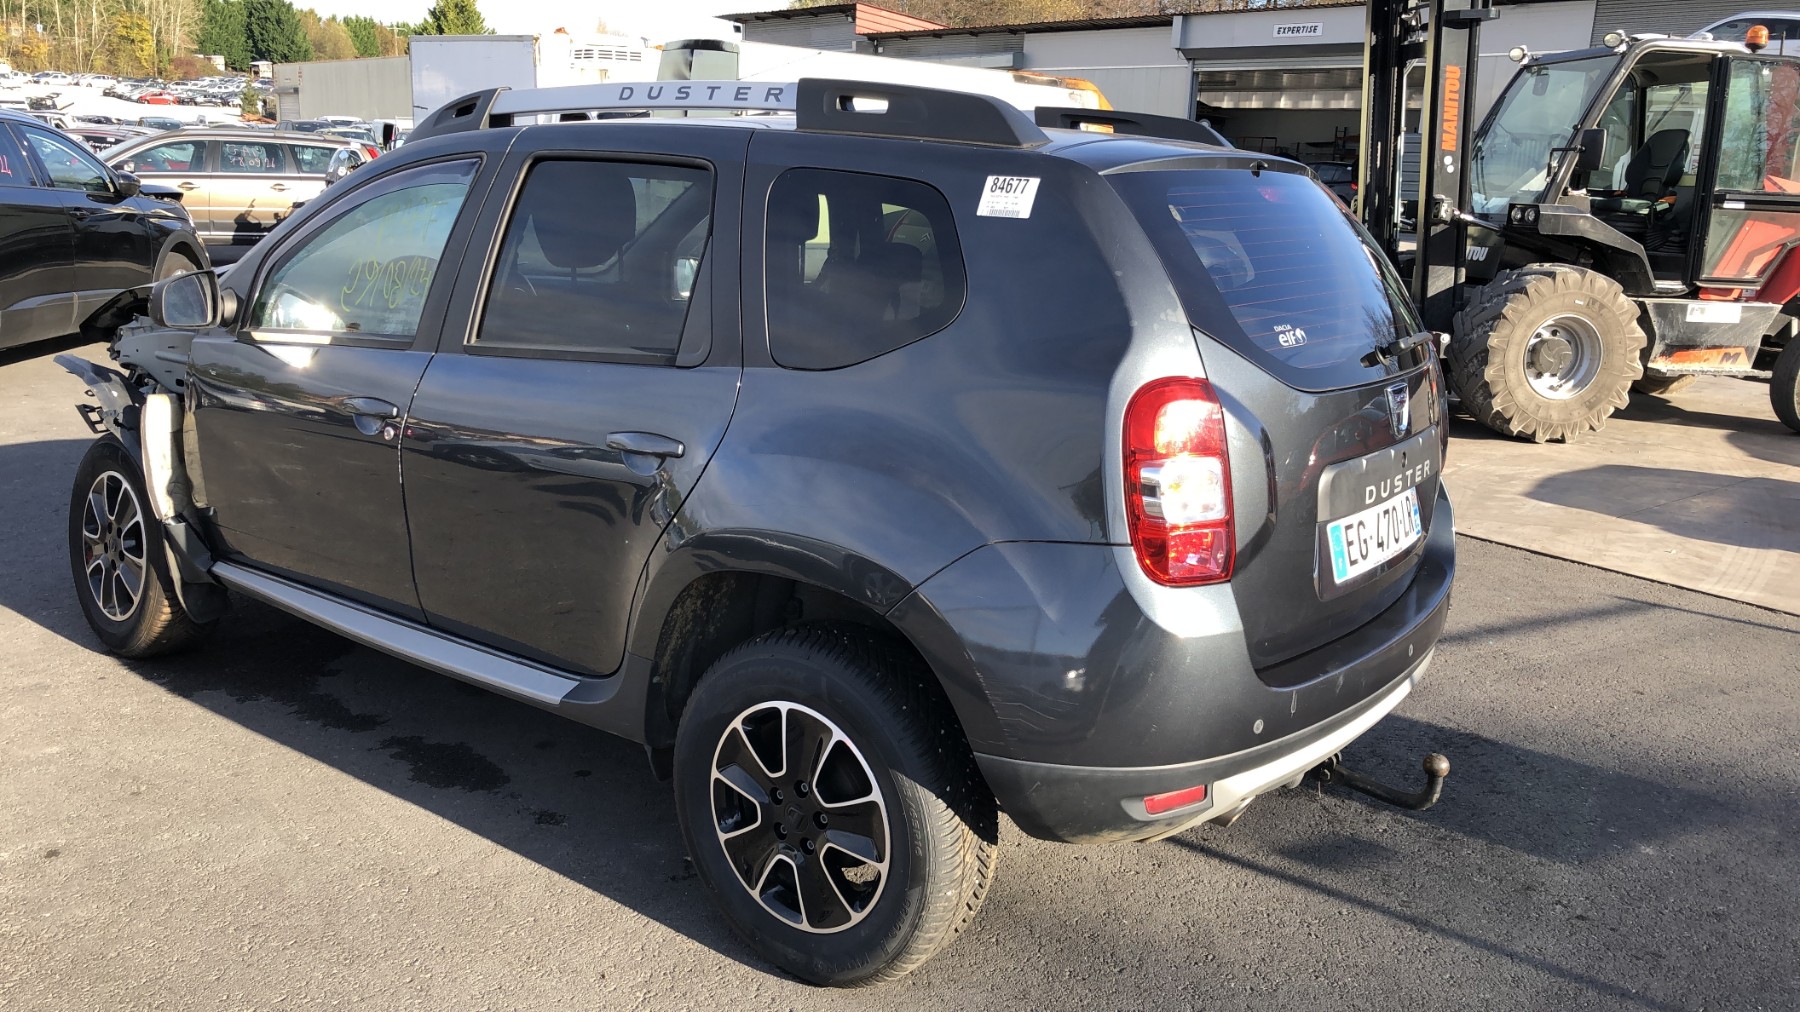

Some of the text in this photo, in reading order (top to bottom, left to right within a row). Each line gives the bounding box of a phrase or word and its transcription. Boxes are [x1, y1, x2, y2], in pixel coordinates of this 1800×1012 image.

[1276, 25, 1319, 35] EXPERTISE
[618, 86, 784, 103] DUSTER
[1441, 64, 1461, 151] MANITOU
[990, 176, 1030, 194] 84677
[1278, 330, 1297, 346] elf
[1365, 459, 1431, 505] DUSTER
